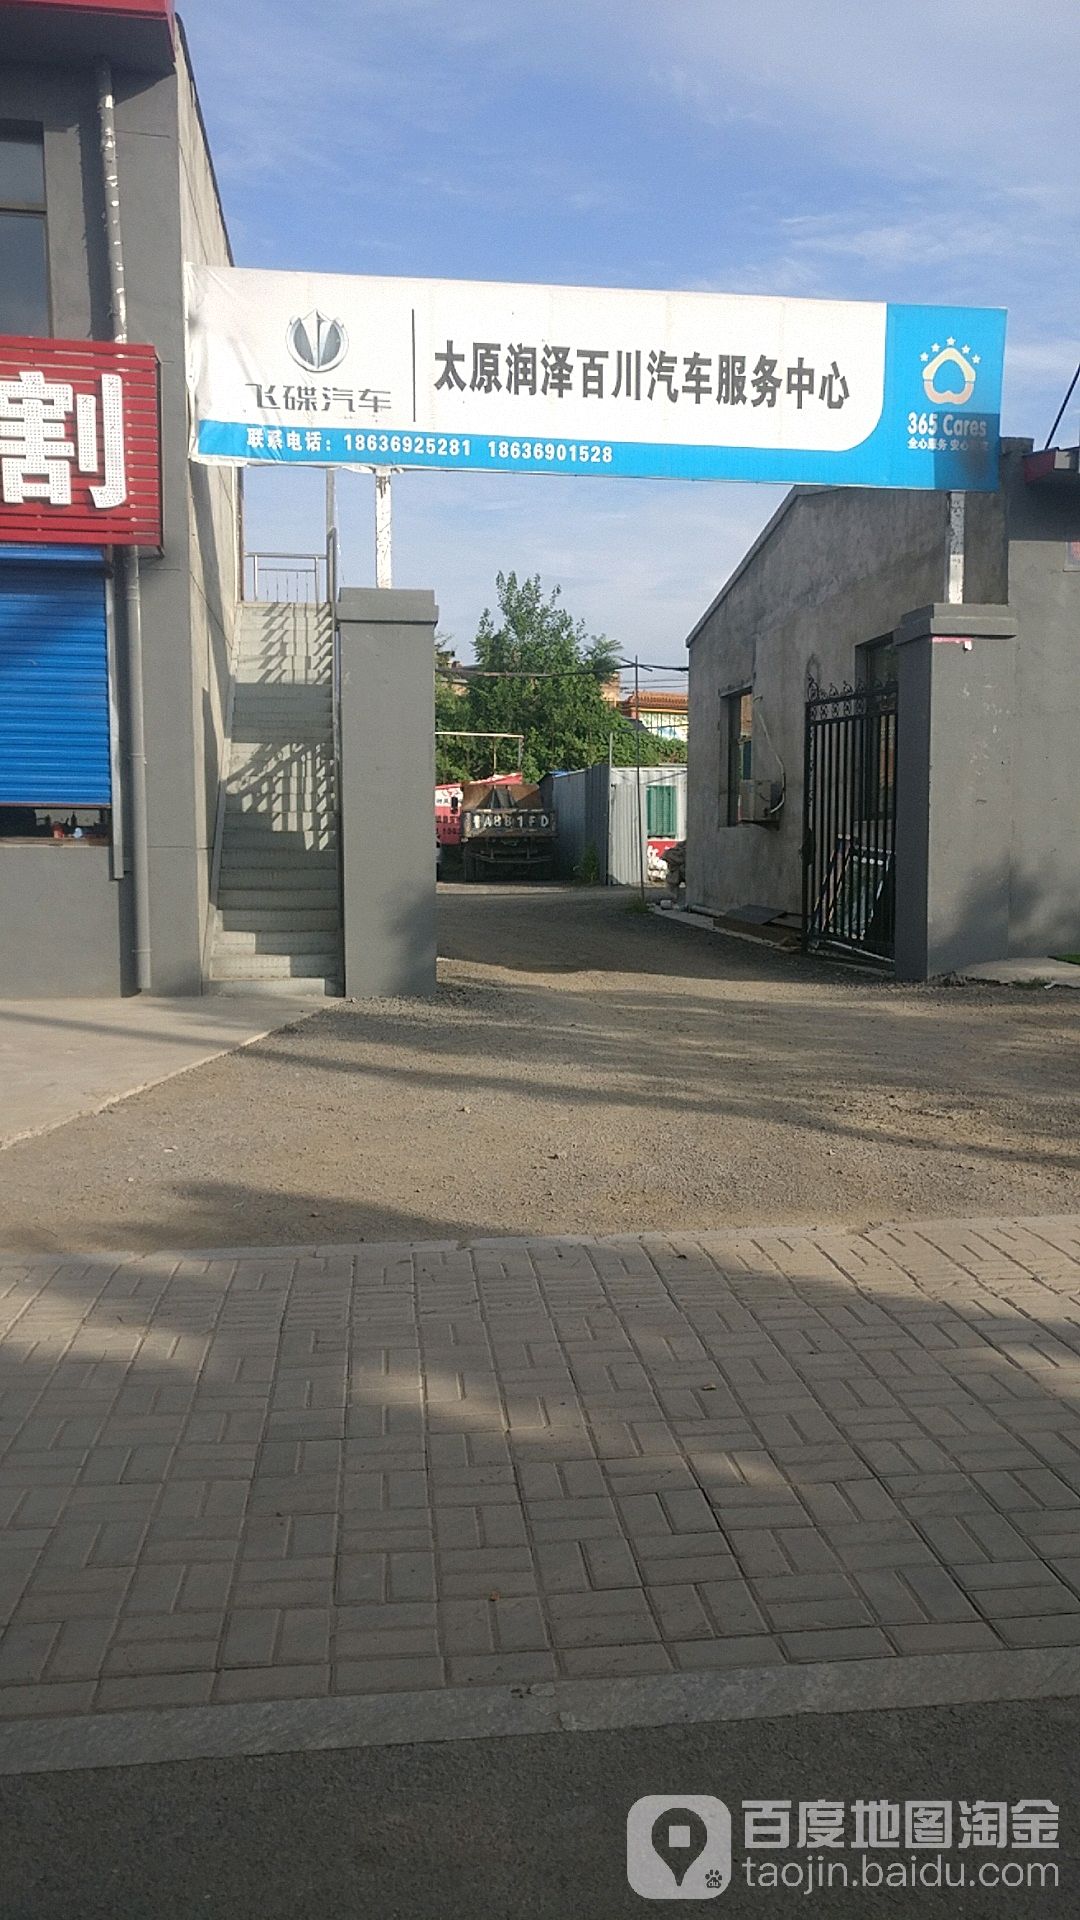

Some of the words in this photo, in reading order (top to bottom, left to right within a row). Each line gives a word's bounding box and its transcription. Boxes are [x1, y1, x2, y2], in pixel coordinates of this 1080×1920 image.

[434, 339, 849, 410] 太原润泽百川汽车服务中心
[245, 383, 392, 413] 飞碟汽车
[907, 411, 938, 436] 365
[942, 414, 987, 438] Cares
[344, 434, 471, 456] 18636925281
[488, 441, 613, 463] 18636901528
